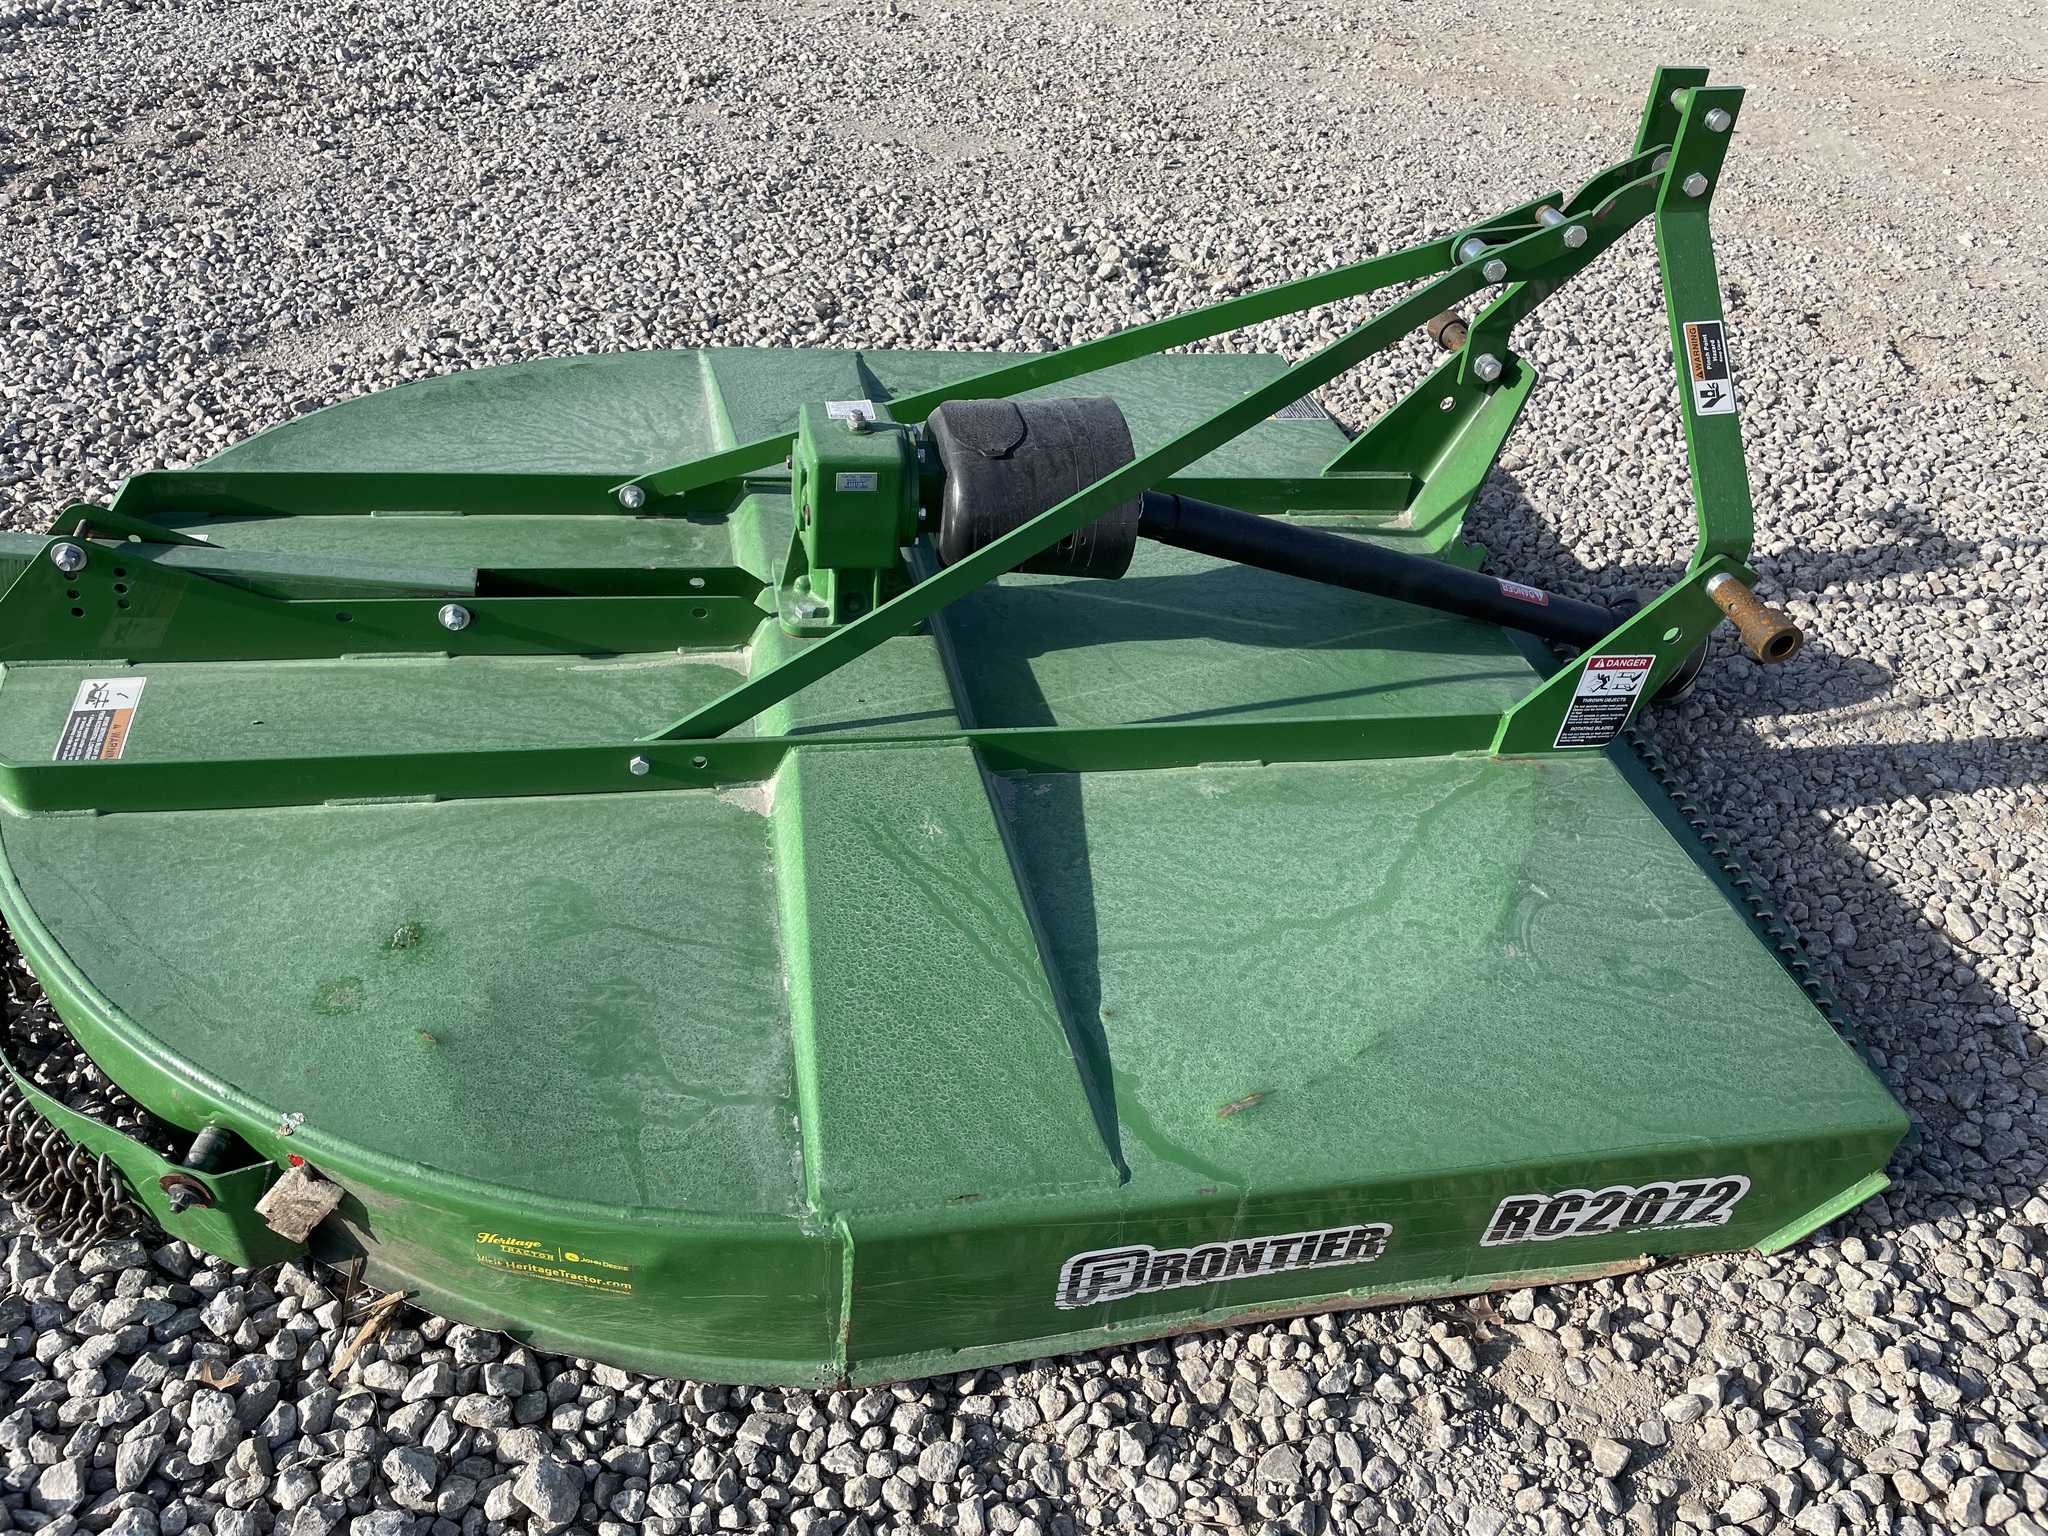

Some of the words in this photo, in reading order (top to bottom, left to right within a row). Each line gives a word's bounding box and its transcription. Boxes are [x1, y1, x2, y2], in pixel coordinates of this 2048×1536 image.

[1689, 327, 1702, 370] WARNING
[1501, 582, 1535, 598] DANGER
[1605, 659, 1647, 668] DANGER
[104, 732, 121, 759] WARNIN
[1484, 1178, 1744, 1244] RC2072
[476, 1232, 542, 1249] Heritage
[500, 1245, 555, 1261] TRACTOR
[505, 1261, 633, 1290] HeritageTractor.com
[580, 1257, 602, 1266] JOHN
[602, 1262, 630, 1272] DEERE
[1060, 1226, 1390, 1306] FRONTIER
